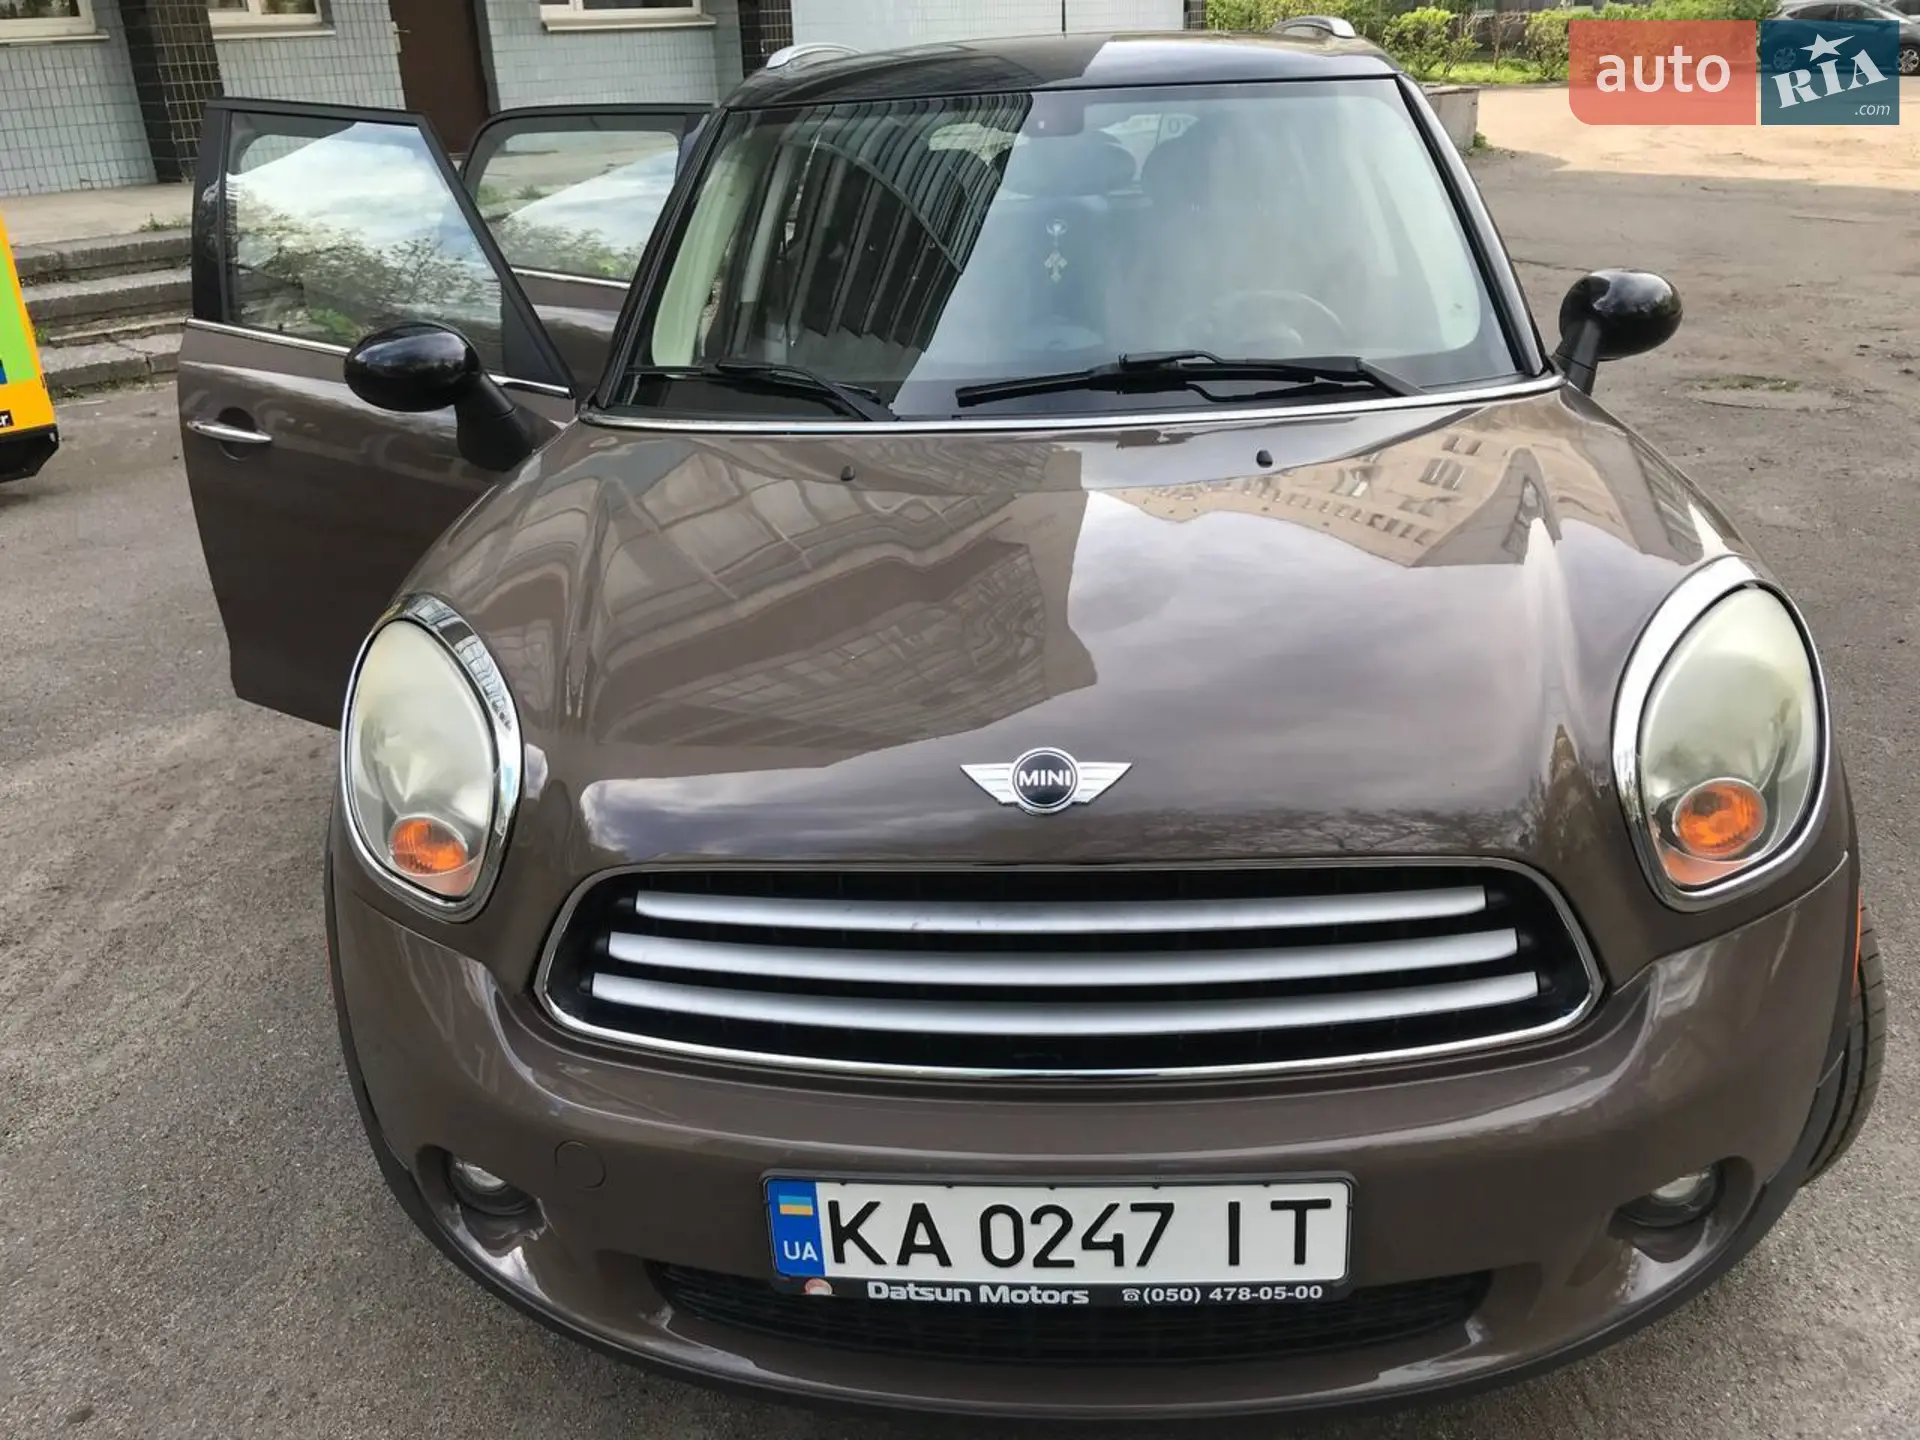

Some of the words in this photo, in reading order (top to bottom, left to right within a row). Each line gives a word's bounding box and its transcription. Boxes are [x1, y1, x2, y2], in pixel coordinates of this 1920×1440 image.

[1018, 769, 1072, 787] MINI
[827, 1200, 953, 1268] KA
[979, 1202, 1175, 1269] 0247
[1227, 1197, 1333, 1267] IT
[783, 1240, 819, 1262] UA
[867, 1280, 971, 1303] Datsun
[979, 1284, 1090, 1305] Motors
[1142, 1286, 1201, 1304] (050)
[1208, 1285, 1324, 1302] 478-05-00
